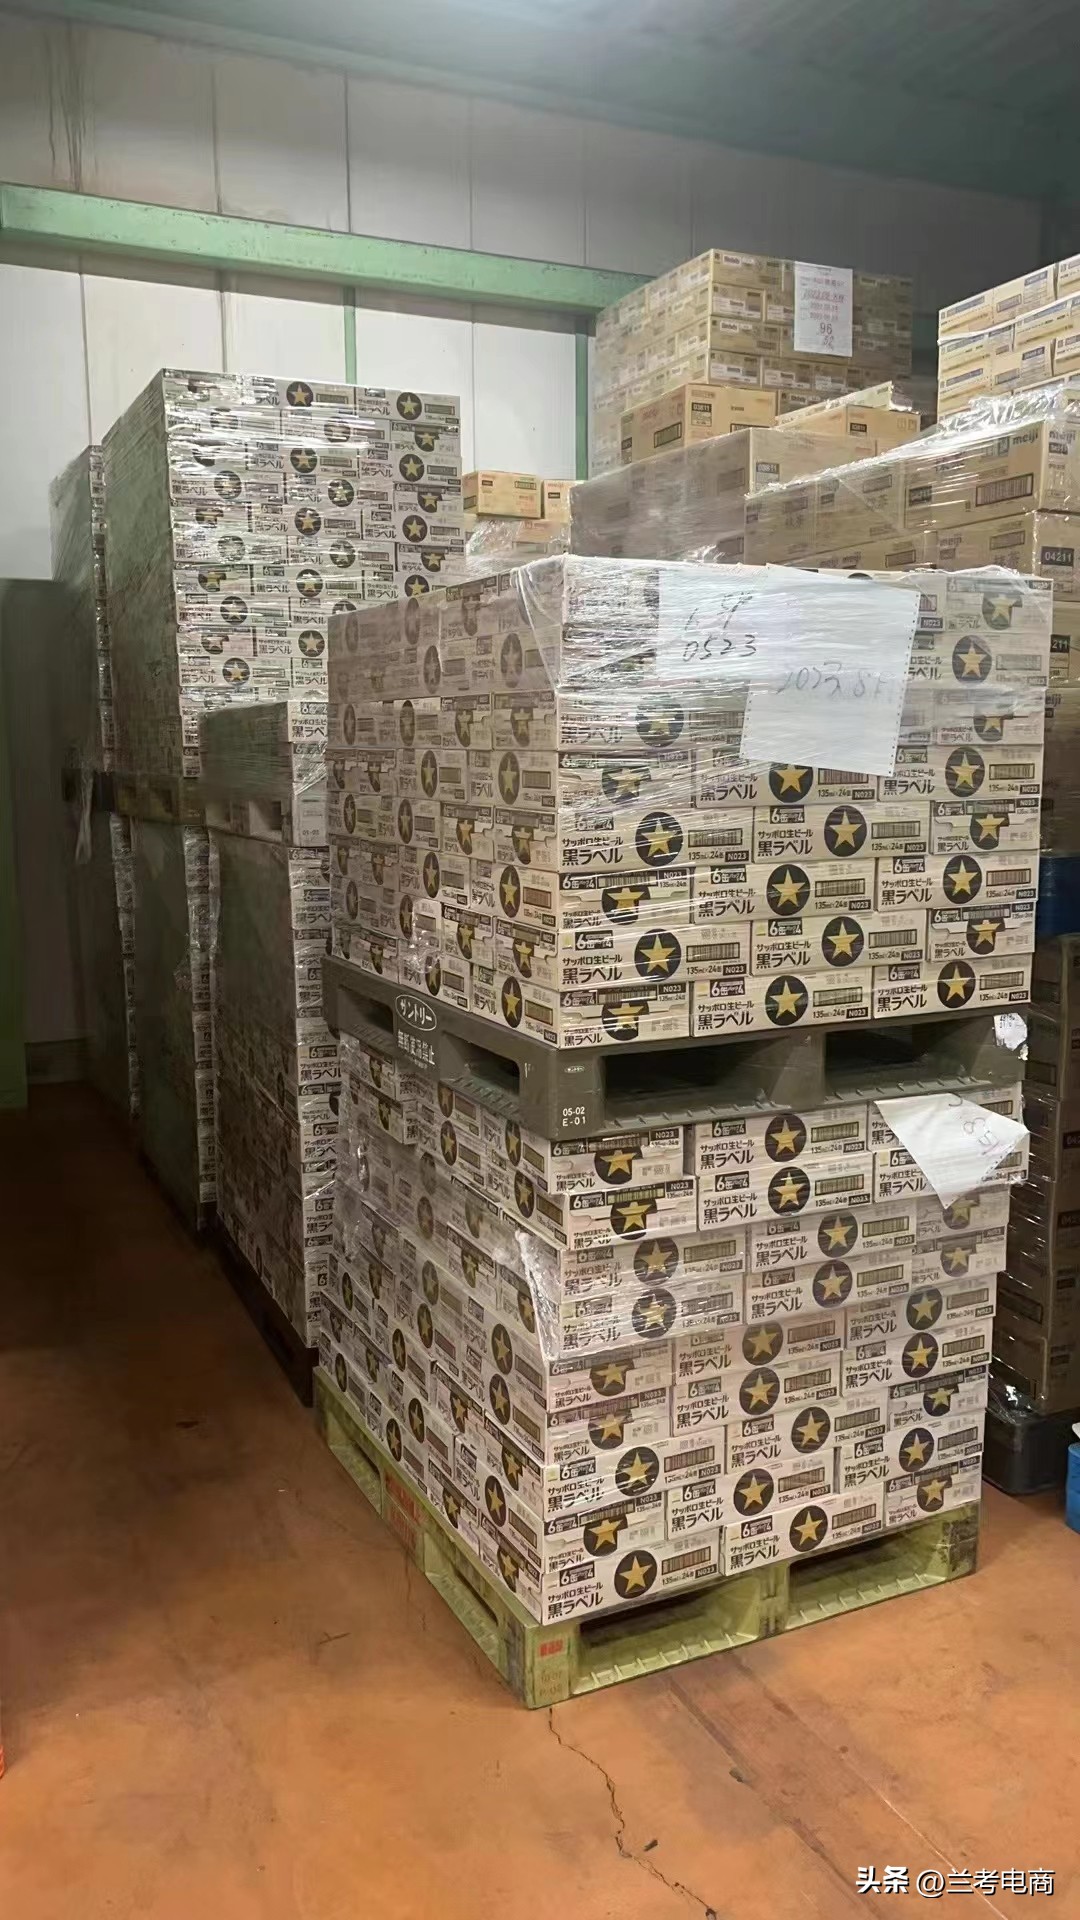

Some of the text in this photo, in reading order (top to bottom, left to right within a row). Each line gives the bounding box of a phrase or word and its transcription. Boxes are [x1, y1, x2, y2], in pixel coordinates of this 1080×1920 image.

[1013, 429, 1038, 445] meiji
[1045, 551, 1072, 562] 04211
[910, 656, 941, 665] ロ生ビール
[909, 667, 941, 680] ラベル
[292, 726, 326, 737] 黒ラベ
[894, 769, 935, 778] ポロ生ビール
[701, 784, 757, 801] 黒ラベル
[854, 790, 873, 798] N023
[884, 779, 935, 796] 黒ラベル
[1022, 785, 1038, 793] N023
[758, 829, 813, 838] サッポロ生ビール
[758, 840, 813, 856] 黒ラベル
[906, 843, 924, 851] N023
[938, 841, 969, 851] 黒ラベル
[562, 849, 623, 866] 黒ラベル
[727, 853, 747, 861] N023
[882, 878, 933, 888] サッポロ生ビール
[882, 888, 932, 905] 黒ラベル
[1018, 890, 1034, 898] N023
[699, 900, 754, 917] 黒ラベル
[851, 901, 869, 909] N023
[1015, 903, 1030, 911] N023
[563, 917, 601, 929] 黒ラベル
[757, 941, 811, 952] サッポロ生ビール
[935, 948, 966, 958] 黒ラベル
[562, 955, 622, 965] サッポロ生ビール
[756, 952, 810, 969] 黒ラベル
[903, 951, 921, 959] N023
[562, 968, 622, 984] 黒ラベル
[725, 966, 744, 974] N023
[878, 984, 927, 996] サッポロ生ビール
[1011, 992, 1027, 1000] N023
[698, 1001, 754, 1012] サッポロ生ビール
[877, 995, 927, 1012] 黒ラベル
[400, 999, 432, 1025] サントリー
[848, 1009, 867, 1017] N023
[698, 1012, 753, 1030] 黒ラベル
[565, 1033, 602, 1046] 黒ラベル
[563, 1107, 585, 1116] 05-02
[656, 1131, 674, 1139] N023
[700, 1140, 754, 1153] サッポロ生ビール
[700, 1150, 754, 1170] 黒ラベル
[880, 1169, 923, 1181] サッポロ生ビー
[556, 1178, 595, 1191] 黒ラベル
[671, 1182, 689, 1190] N023
[879, 1177, 926, 1197] 黒ラベル
[703, 1193, 757, 1206] サッポロ生ビール
[703, 1204, 757, 1224] 黒ラベル
[756, 1236, 808, 1249] サッポロ生ビール
[756, 1247, 807, 1267] 黒ラベル
[564, 1274, 622, 1296] 黒ラベル
[751, 1287, 803, 1301] サッポロ生ビール
[751, 1298, 803, 1319] 黒ラベル
[850, 1323, 897, 1340] 黒ラベル
[679, 1356, 731, 1377] 黒ラベル
[845, 1370, 892, 1388] 黒ラベル
[818, 1388, 835, 1397] N023
[555, 1394, 591, 1408] 黒ラベル
[676, 1395, 729, 1411] サッポロ生ビール
[677, 1408, 729, 1429] 黒ラベル
[867, 1427, 884, 1436] N023
[732, 1435, 781, 1451] サッポロ生ビール
[554, 1448, 590, 1462] 黒ラベル
[732, 1445, 781, 1468] 黒ラベル
[701, 1467, 718, 1475] N023
[845, 1468, 889, 1488] 黒ラベル
[812, 1487, 829, 1496] N023
[672, 1498, 724, 1515] サッポロ生ビール
[671, 1510, 724, 1532] 黒ラベル
[730, 1535, 780, 1554] サッポロ生ビール
[549, 1555, 584, 1571] 黒ラベル
[730, 1547, 779, 1569] 黒ラベル
[697, 1566, 715, 1576] N023
[548, 1583, 603, 1601] サッポロ生ビール
[548, 1593, 603, 1619] 黒ラベル
